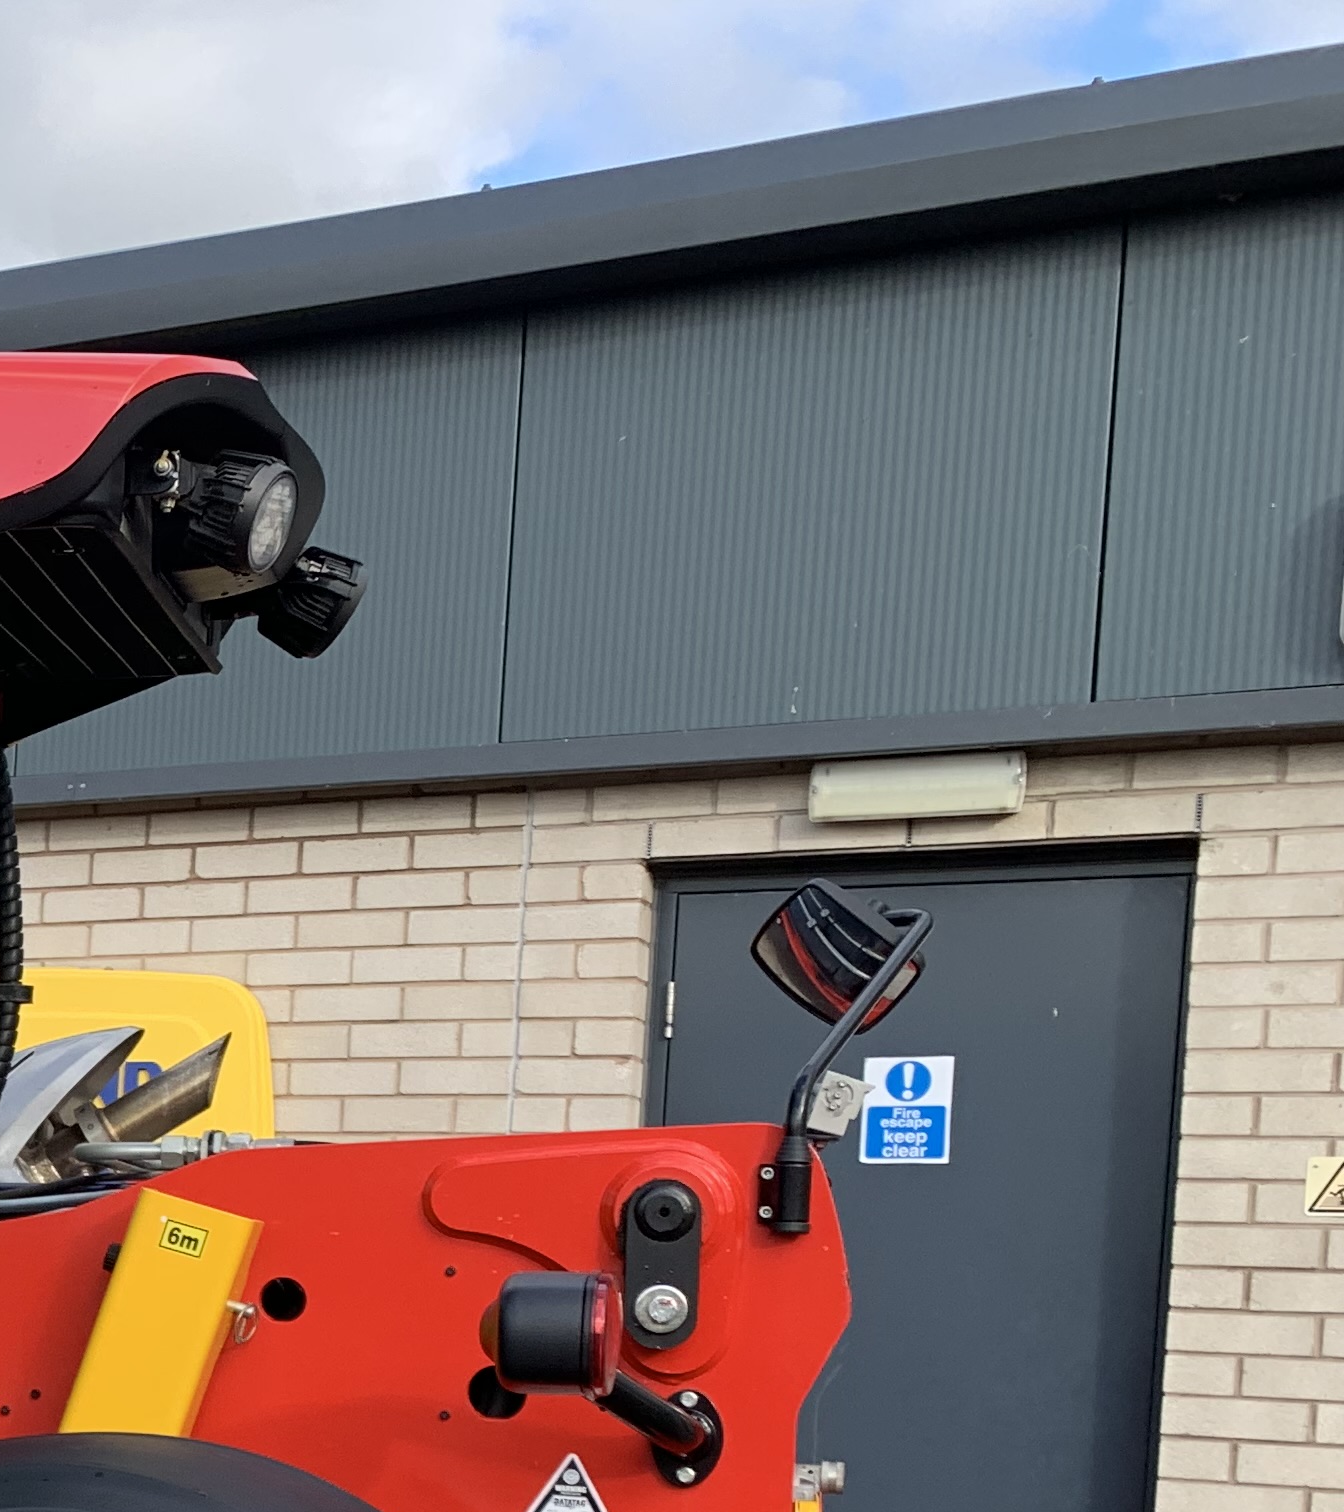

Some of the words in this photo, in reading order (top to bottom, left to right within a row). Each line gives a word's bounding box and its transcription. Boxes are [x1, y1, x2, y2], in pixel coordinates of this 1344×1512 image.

[893, 1107, 921, 1119] Fire
[880, 1118, 932, 1130] escape
[883, 1129, 928, 1146] keep
[882, 1144, 928, 1157] clear
[167, 1227, 199, 1251] 6m
